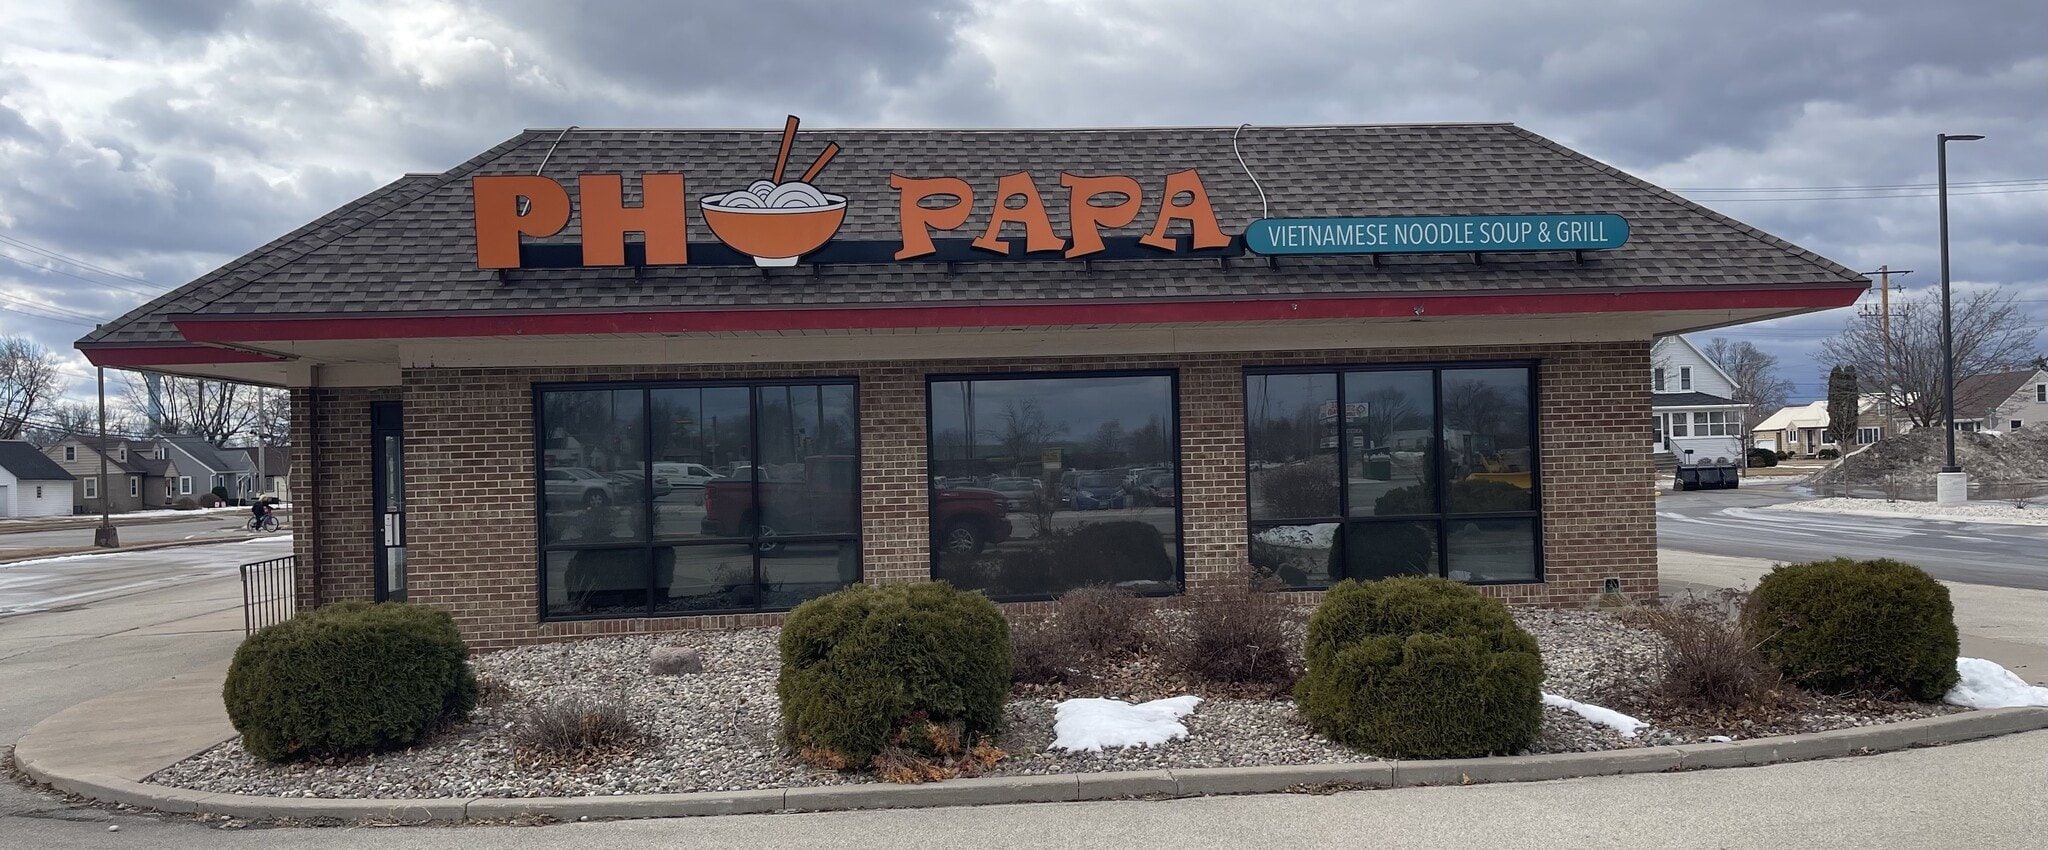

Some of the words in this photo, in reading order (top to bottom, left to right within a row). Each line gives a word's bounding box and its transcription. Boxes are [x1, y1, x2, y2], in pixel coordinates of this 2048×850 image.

[890, 168, 1232, 260] PAPA
[1268, 223, 1388, 247] VIETNAMESE
[1395, 222, 1474, 245] NOODLE
[1479, 222, 1532, 244] SOUP
[1538, 221, 1551, 243] &
[1556, 221, 1608, 242] GRILL
